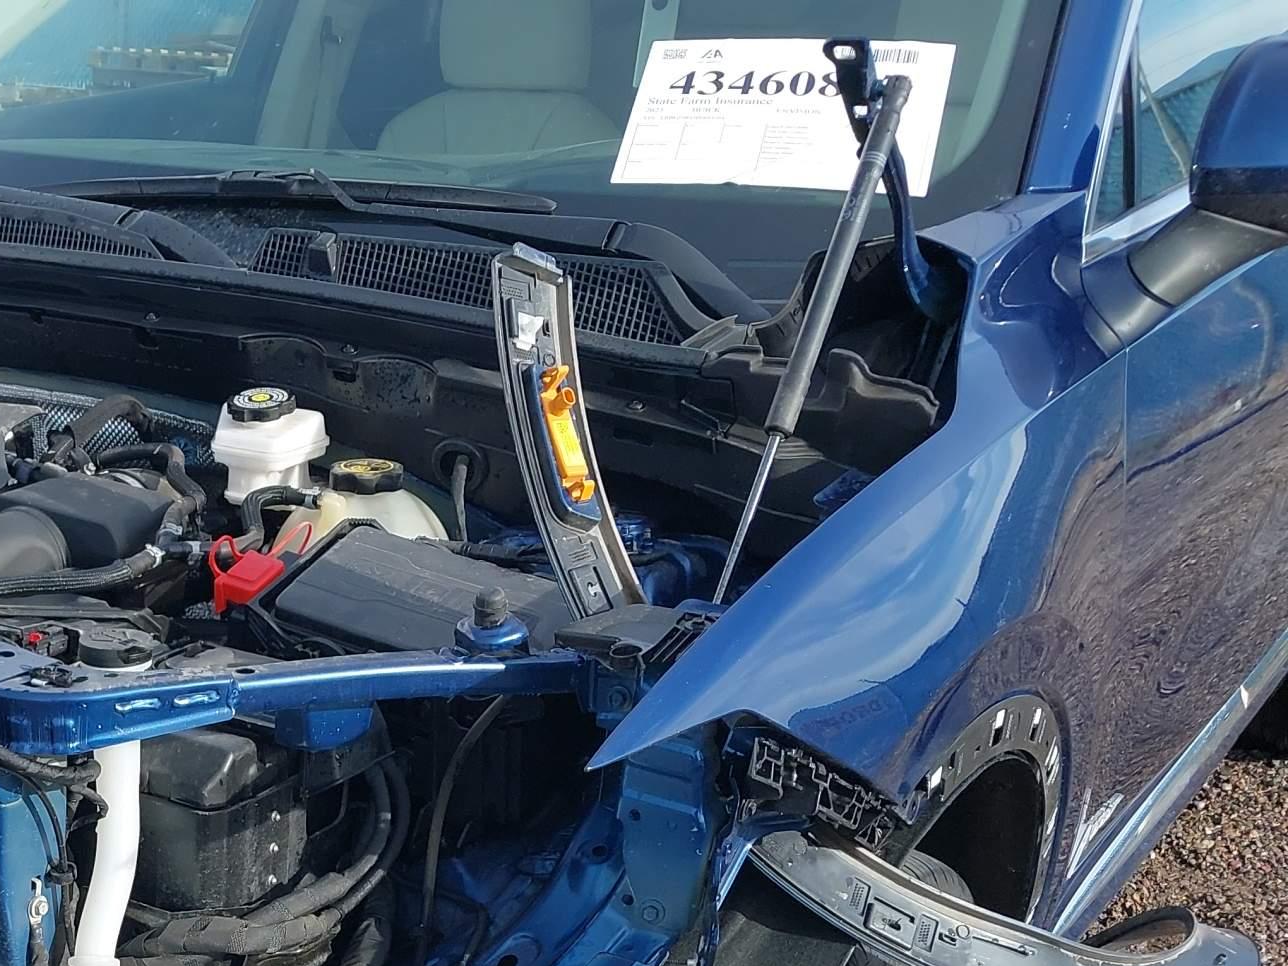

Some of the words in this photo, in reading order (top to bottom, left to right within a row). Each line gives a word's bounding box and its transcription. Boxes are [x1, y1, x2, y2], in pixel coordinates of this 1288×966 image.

[647, 97, 675, 105] State
[680, 97, 711, 105] Farm
[715, 97, 774, 105] Insurance
